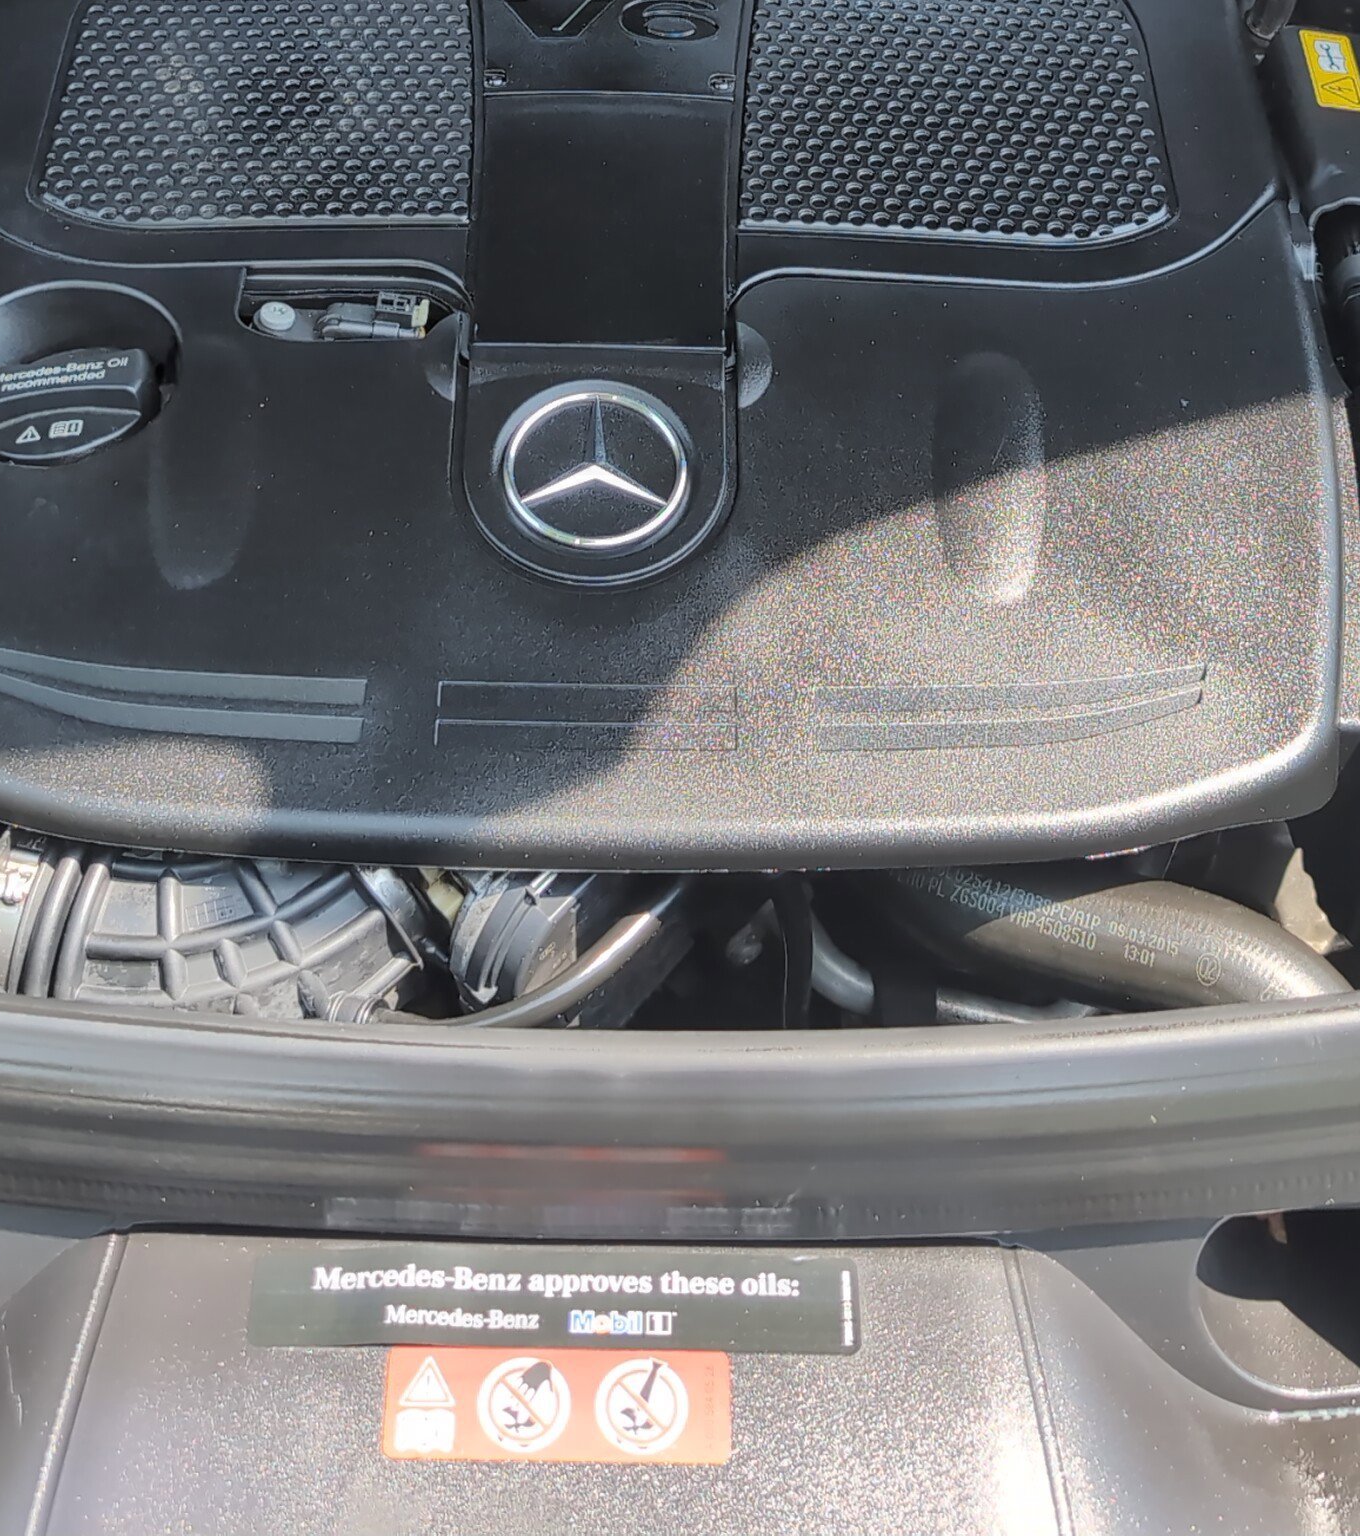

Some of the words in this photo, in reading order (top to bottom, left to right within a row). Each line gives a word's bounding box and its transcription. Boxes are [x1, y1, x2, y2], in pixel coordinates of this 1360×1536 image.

[106, 356, 130, 369] Oil
[0, 368, 106, 393] recommended
[312, 1265, 522, 1293] Mercedes-Benz
[528, 1270, 653, 1299] approves
[660, 1270, 735, 1296] these
[740, 1271, 801, 1297] oils:
[383, 1303, 540, 1331] Mercedes-Benz
[568, 1309, 643, 1334] Mobil
